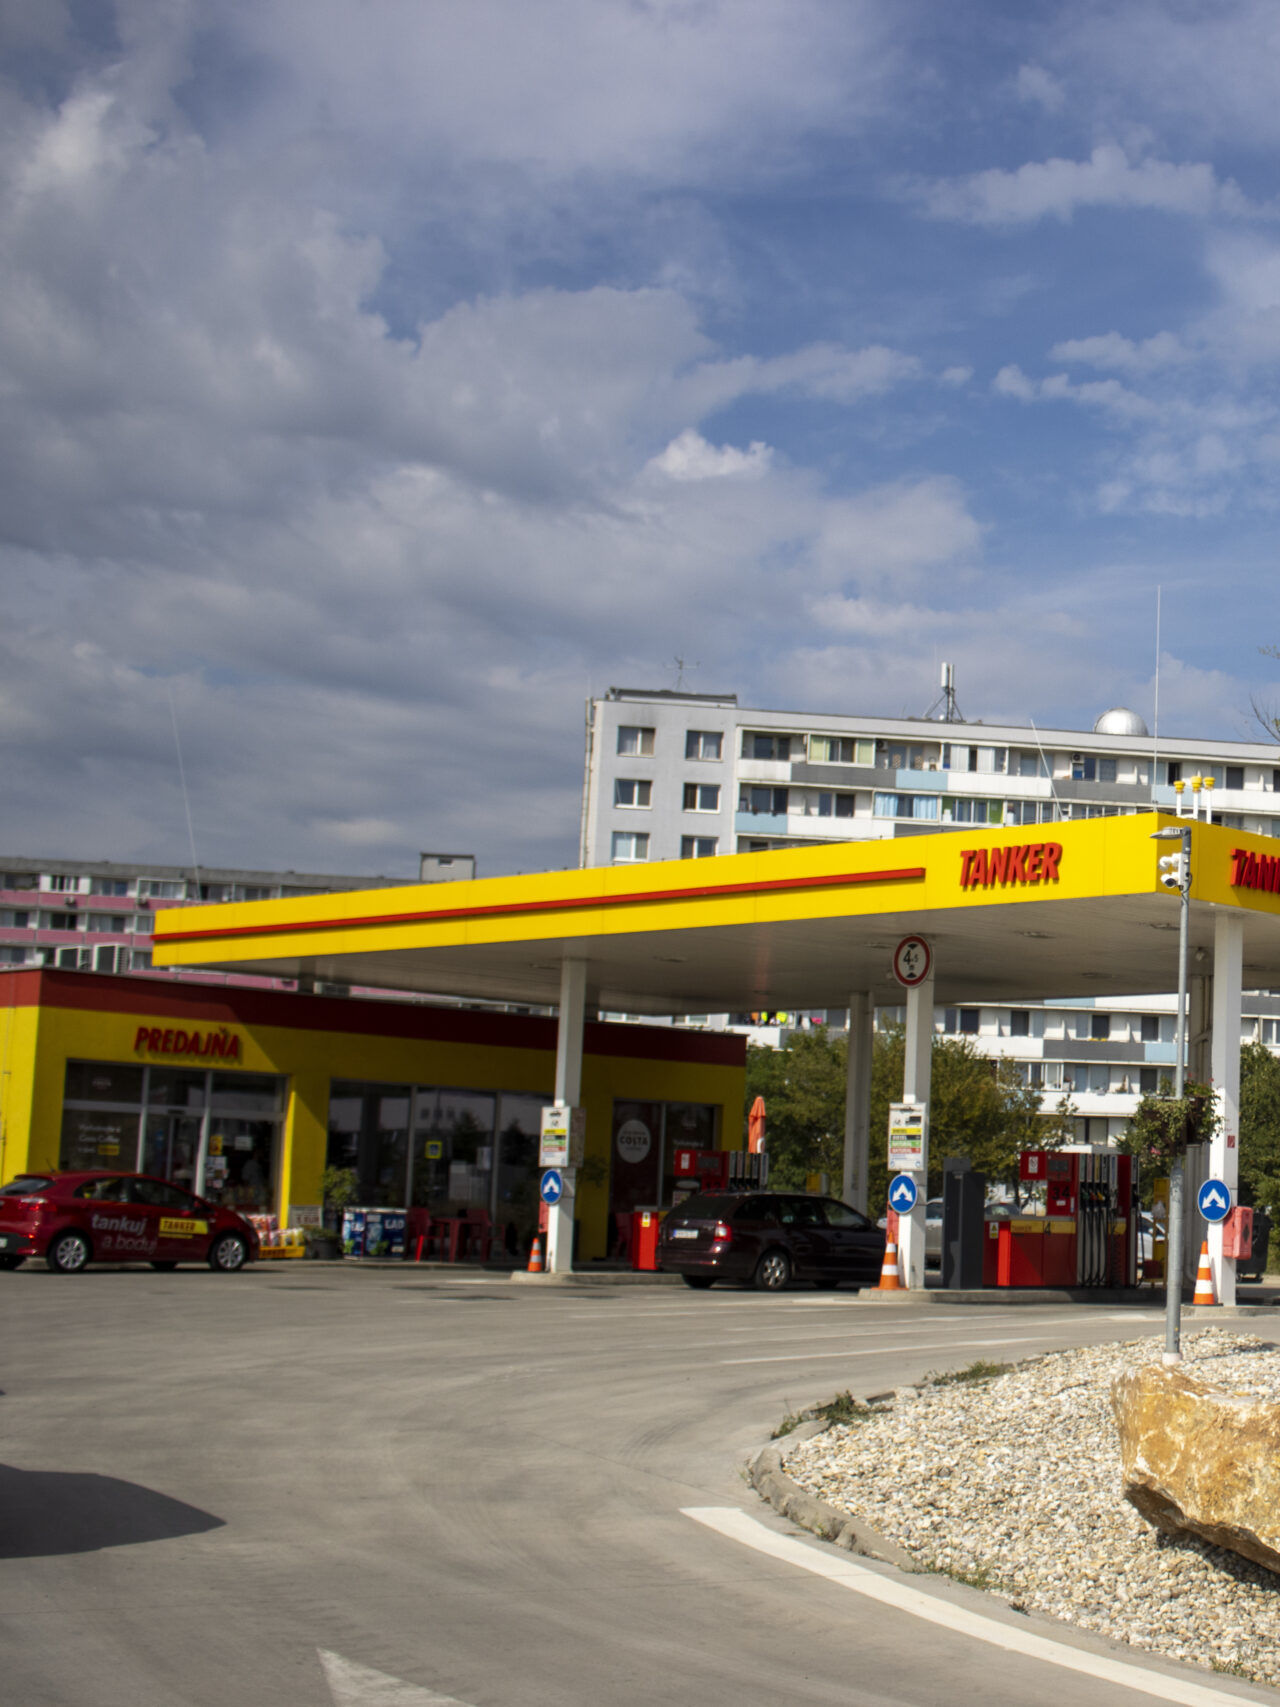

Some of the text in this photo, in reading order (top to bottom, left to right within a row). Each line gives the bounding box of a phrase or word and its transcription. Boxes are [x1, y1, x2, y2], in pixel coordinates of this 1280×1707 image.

[960, 842, 1063, 889] TANKER
[134, 1026, 239, 1058] PREDAJŇA
[620, 1134, 649, 1146] COSTA
[91, 1213, 147, 1236] tankuj
[163, 1220, 197, 1232] TANKER
[102, 1236, 112, 1248] a
